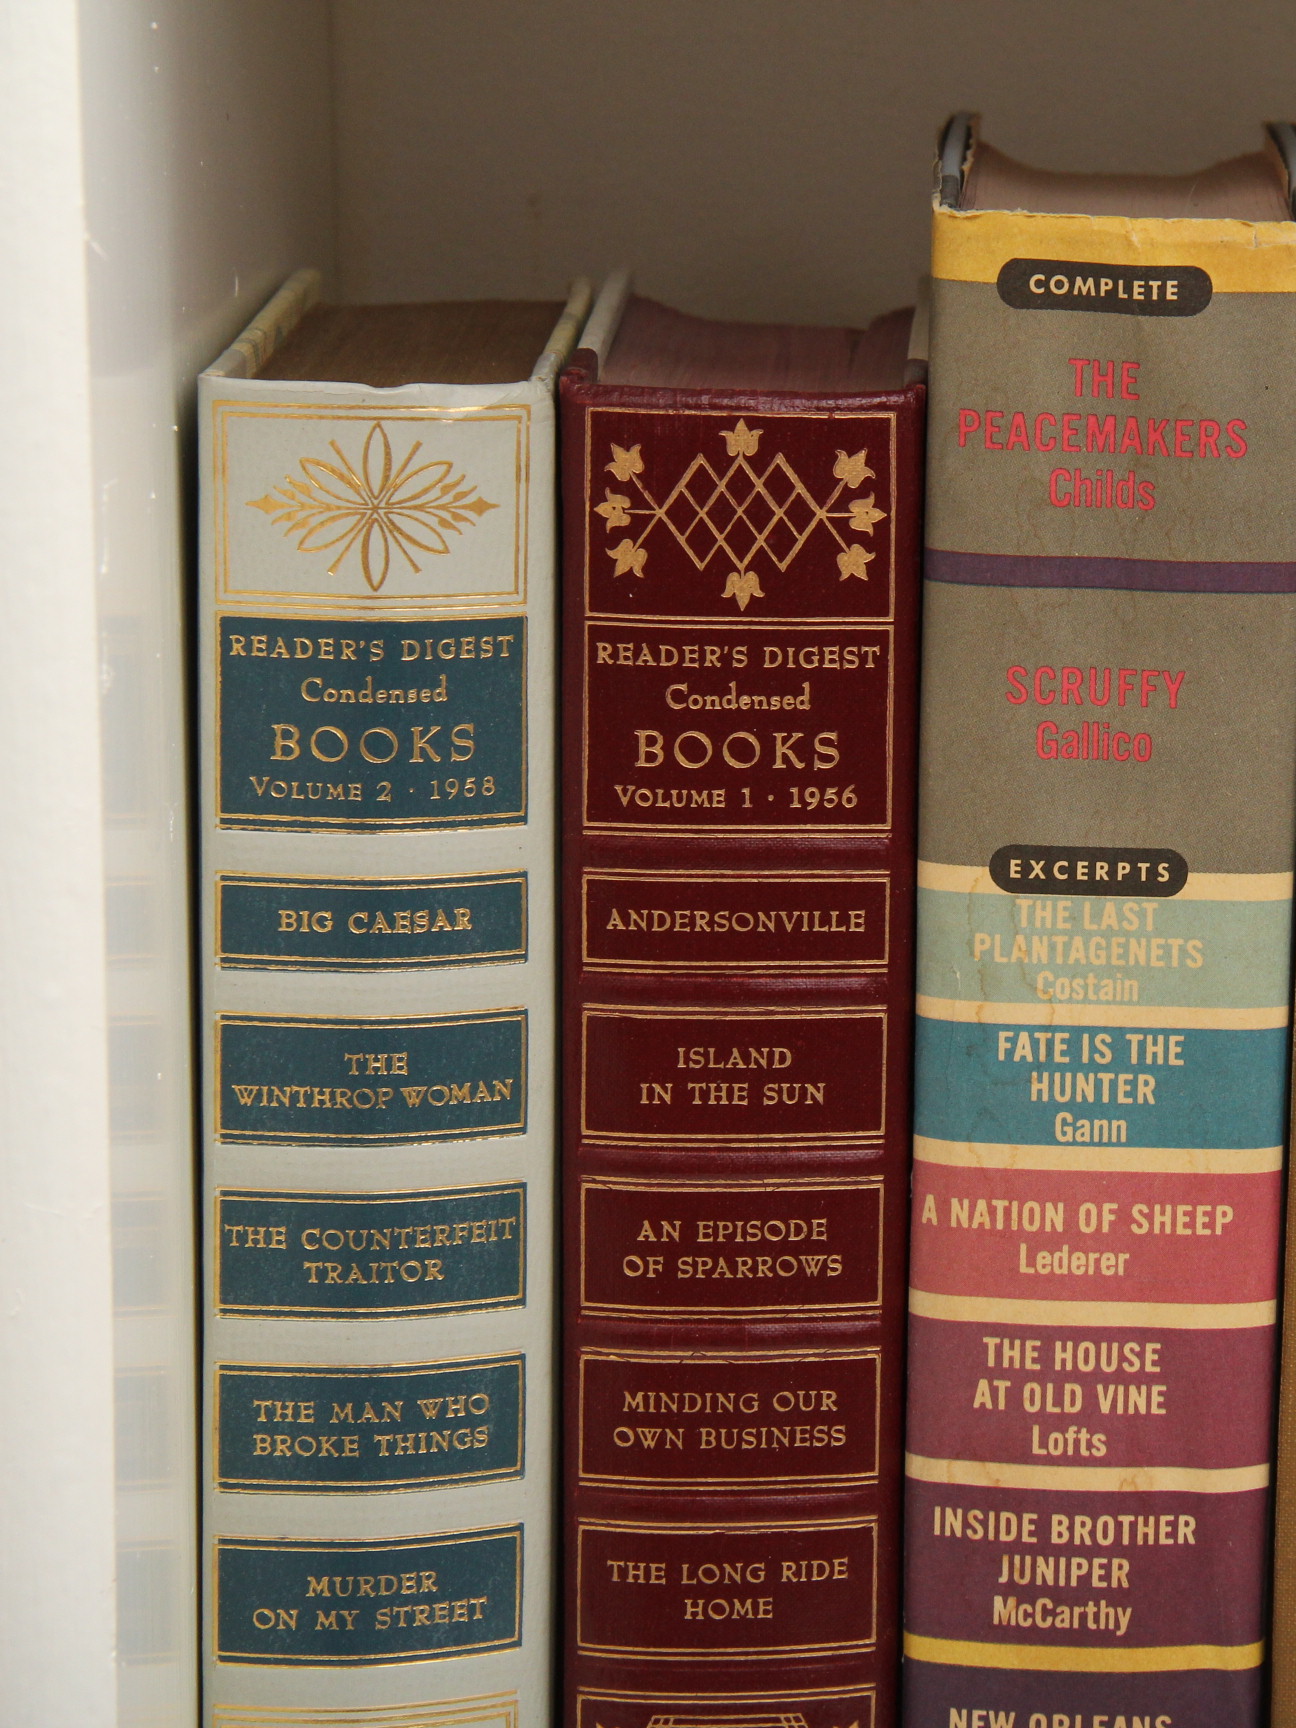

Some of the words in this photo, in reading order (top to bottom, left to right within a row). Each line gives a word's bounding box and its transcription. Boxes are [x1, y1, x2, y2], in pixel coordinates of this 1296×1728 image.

[1028, 273, 1179, 301] COMPLETE
[1067, 358, 1141, 401] THE
[957, 408, 1249, 459] PEACEMAKERS
[1048, 467, 1156, 511] Childs
[228, 634, 385, 662] READER'S
[400, 634, 515, 661] DIGEST
[595, 641, 749, 669] READER'S
[762, 644, 881, 671] DIGEST
[300, 674, 448, 705] Condensed
[664, 681, 812, 711] Condensed
[1005, 665, 1186, 710] SCRUFFY
[269, 722, 475, 763] BOOKS
[633, 728, 841, 771] BOOKS
[1035, 720, 1153, 763] Gallico
[249, 776, 363, 801] VOLUME
[375, 781, 393, 803] 2
[429, 776, 497, 800] 1958
[613, 784, 727, 809] VOLUME
[741, 787, 753, 809] 1
[789, 784, 859, 811] 1956
[1008, 859, 1172, 883] EXCERPTS
[277, 908, 335, 934] BIG
[347, 908, 473, 935] CAESAR
[606, 908, 866, 934] ANDERSONVILLE
[1014, 898, 1072, 930] THE
[1082, 900, 1159, 933] LAST
[973, 933, 1205, 969] PLANTAGENETS
[1035, 970, 1139, 1003] Costain
[344, 1051, 409, 1076] THE
[676, 1047, 793, 1070] ISLAND
[997, 1031, 1070, 1064] FATE
[1081, 1033, 1112, 1066] IS
[1125, 1033, 1186, 1066] THE
[231, 1083, 395, 1110] WINTHROP
[399, 1078, 515, 1109] WOMAN
[639, 1082, 674, 1105] IN
[687, 1081, 750, 1106] THE
[762, 1082, 827, 1106] SUN
[1029, 1071, 1156, 1105] HUNTER
[1054, 1111, 1128, 1144] Gann
[636, 1219, 681, 1244] AN
[696, 1217, 829, 1244] EPISODE
[921, 1194, 938, 1226] A
[950, 1197, 1064, 1233] NATION
[1078, 1201, 1118, 1234] OF
[1129, 1203, 1234, 1236] SHEEP
[224, 1223, 288, 1250] THE
[300, 1215, 517, 1252] COUNTERFEIT
[303, 1258, 445, 1285] TRAITOR
[622, 1254, 664, 1279] OF
[677, 1254, 844, 1279] SPARROWS
[1018, 1242, 1130, 1277] Lederer
[982, 1336, 1041, 1371] THE
[1054, 1340, 1162, 1374] HOUSE
[252, 1399, 316, 1424] THE
[328, 1400, 404, 1424] MAN
[416, 1392, 490, 1420] WHO
[621, 1390, 760, 1414] MINDING
[772, 1390, 839, 1413] OUR
[973, 1378, 1011, 1411] AT
[1022, 1381, 1083, 1415] OLD
[1096, 1383, 1167, 1416] VINE
[252, 1433, 361, 1458] BROKE
[373, 1425, 490, 1458] THINGS
[612, 1426, 685, 1451] OWN
[699, 1424, 847, 1451] BUSINESS
[1031, 1424, 1108, 1458] Lofts
[932, 1505, 1038, 1544] INSIDE
[1050, 1513, 1197, 1547] BROTHER
[305, 1570, 439, 1598] MURDER
[606, 1559, 667, 1586] THE
[680, 1562, 767, 1586] LONG
[780, 1556, 849, 1583] RIDE
[997, 1553, 1130, 1589] JUNIPER
[252, 1607, 300, 1632] ON
[314, 1609, 361, 1632] MY
[374, 1596, 488, 1631] STREET
[683, 1597, 774, 1621] HOME
[992, 1594, 1133, 1636] McCarthy
